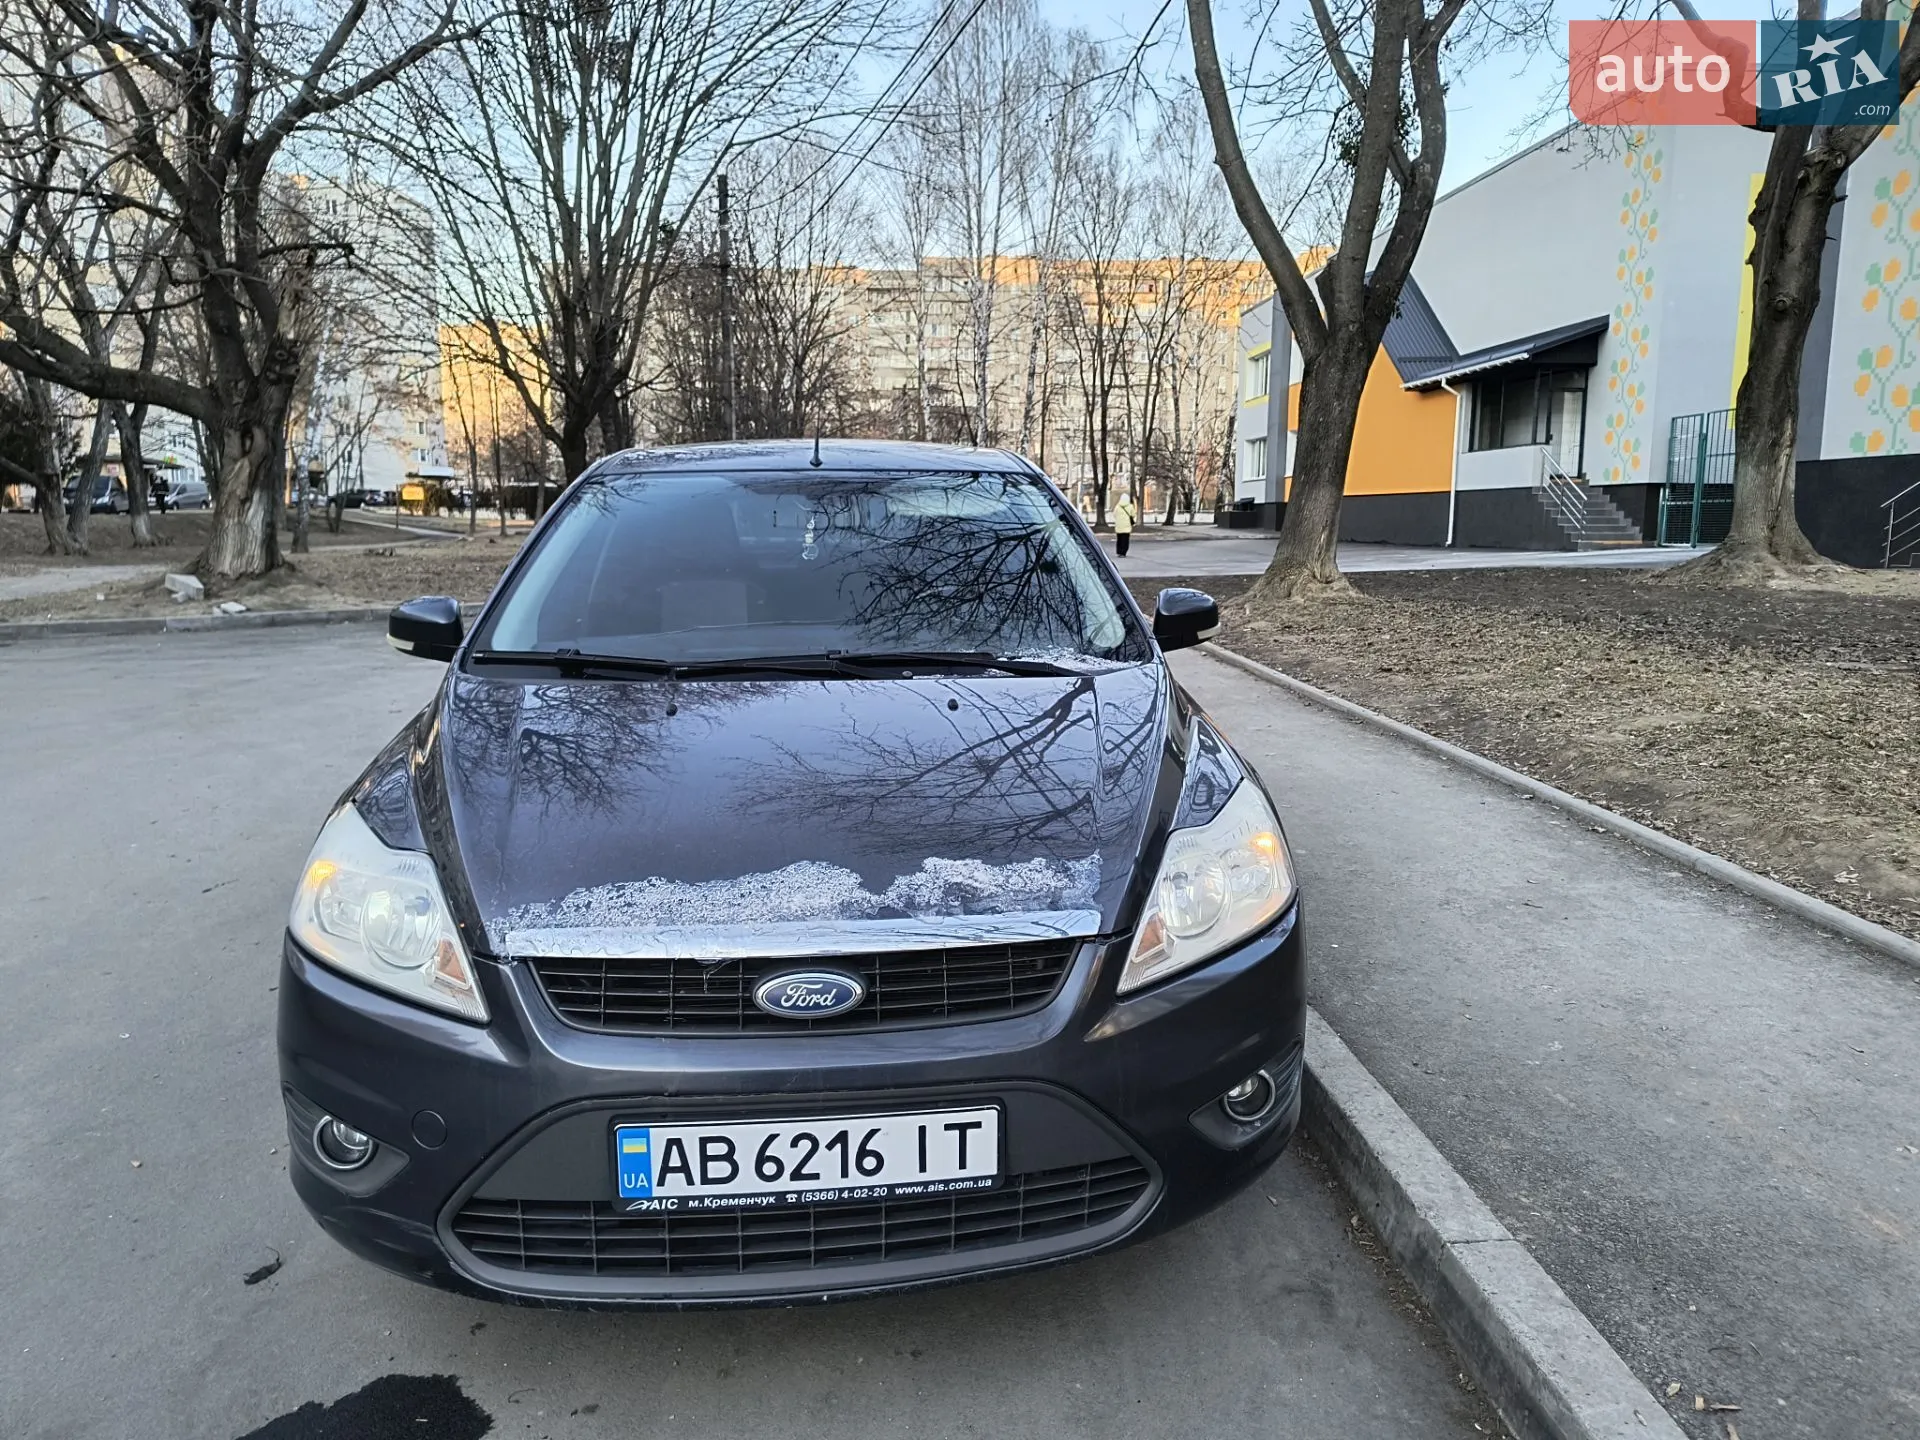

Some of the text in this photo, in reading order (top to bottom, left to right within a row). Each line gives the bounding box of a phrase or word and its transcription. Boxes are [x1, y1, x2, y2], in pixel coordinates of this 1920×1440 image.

[781, 983, 837, 1008] Ford
[656, 1120, 983, 1187] AB 6216 IT
[623, 1173, 649, 1189] UA
[801, 1191, 839, 1203] (5366)
[841, 1187, 888, 1199] 4-02-20
[894, 1178, 993, 1195] www.ais.com.ua
